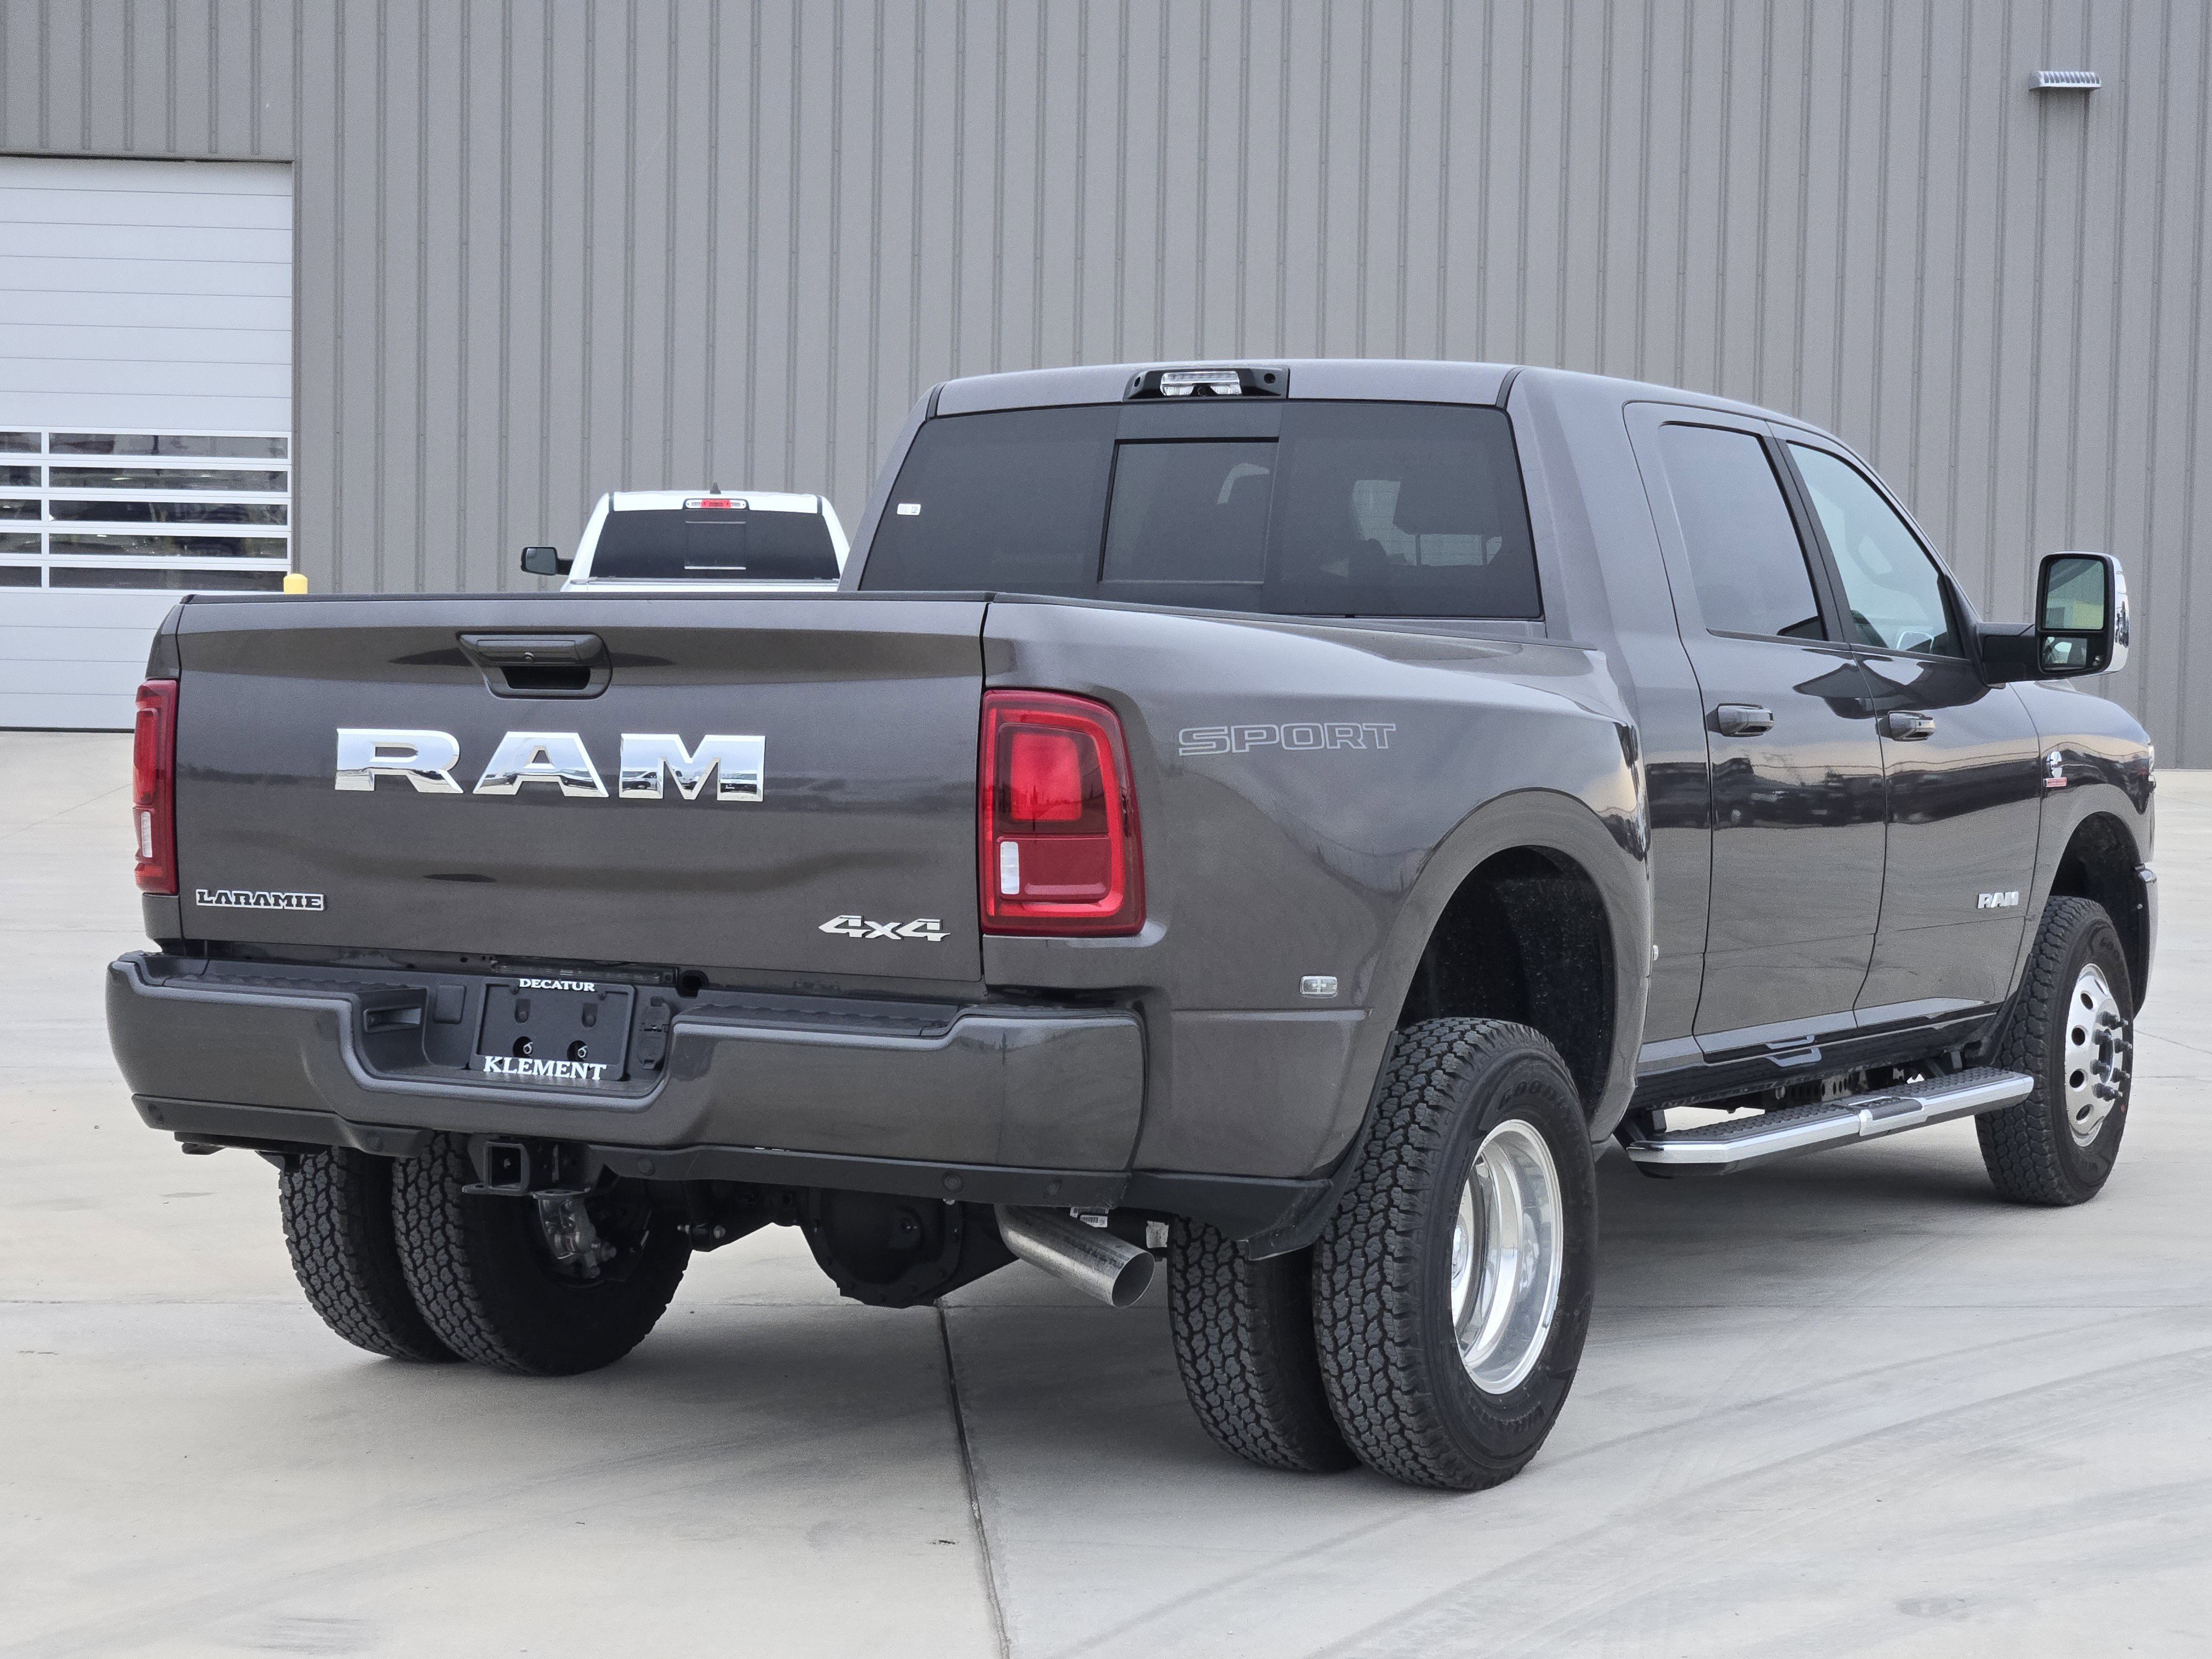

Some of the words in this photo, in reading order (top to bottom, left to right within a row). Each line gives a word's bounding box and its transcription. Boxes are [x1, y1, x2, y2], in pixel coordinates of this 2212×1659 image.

[1178, 722, 1396, 756] SPORT
[334, 728, 766, 802] RAM
[195, 889, 325, 911] LARAMIE
[1976, 891, 2019, 909] RAM
[818, 915, 951, 941] 4x4
[519, 978, 596, 992] DECATUR
[483, 1056, 607, 1081] KLEMENT
